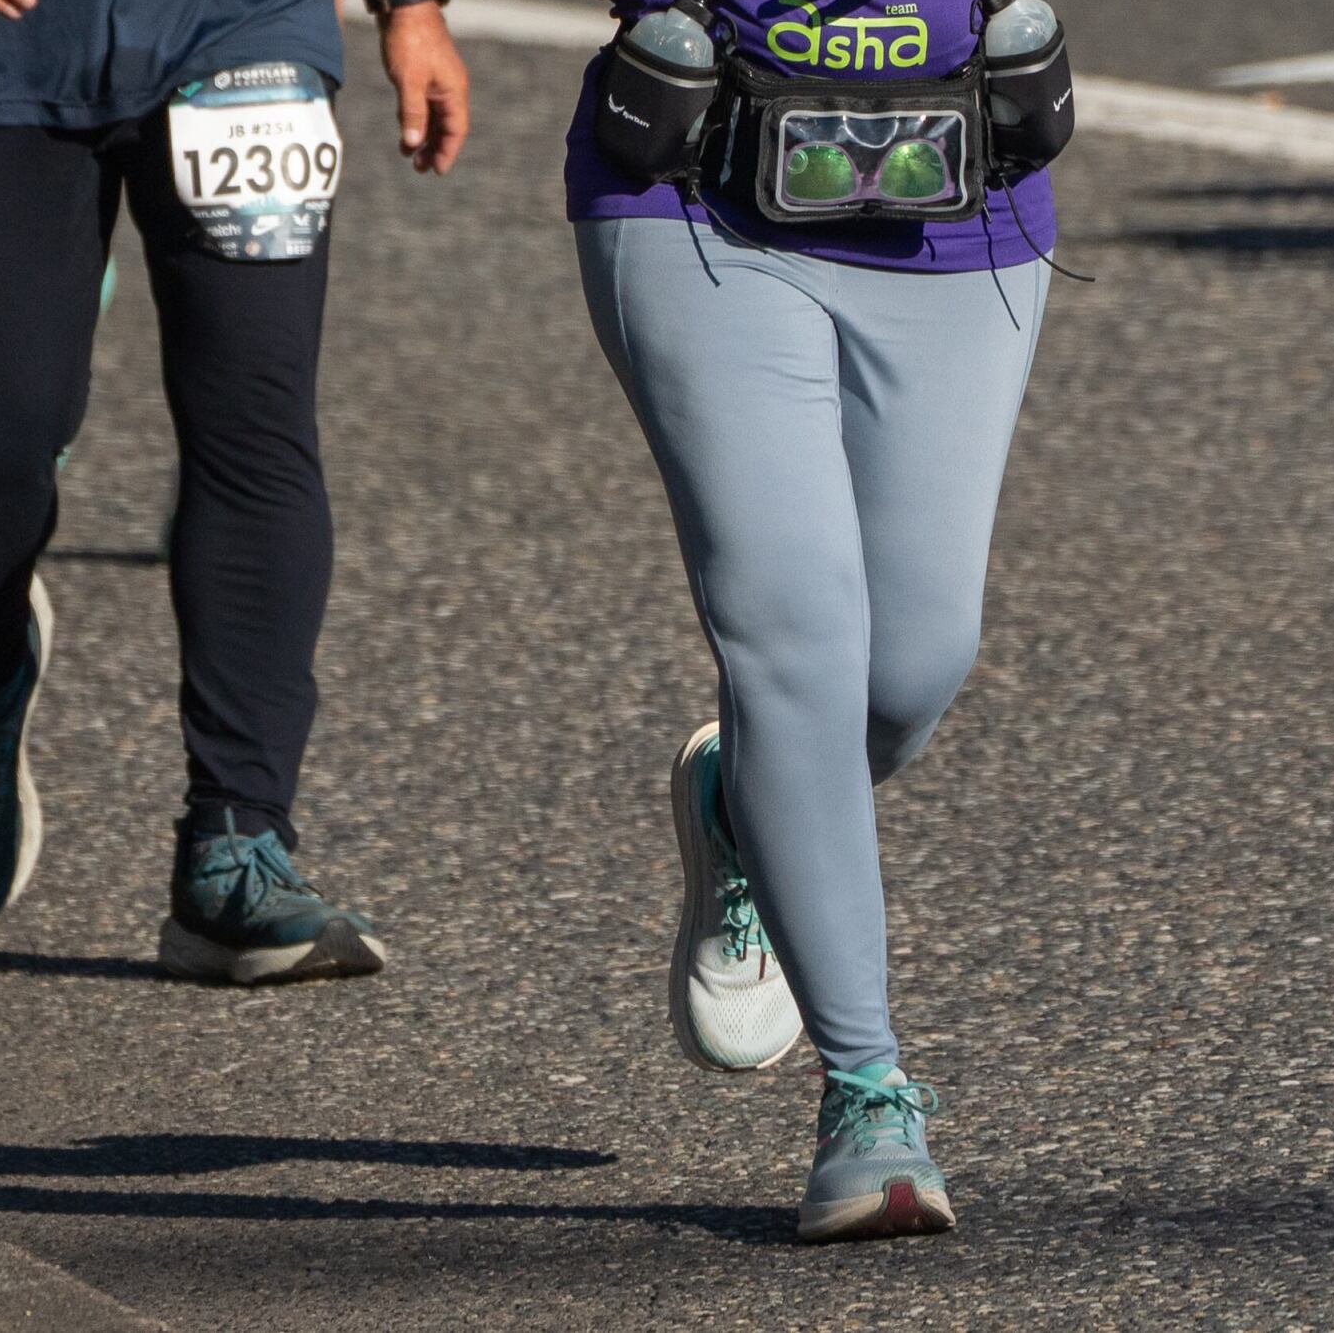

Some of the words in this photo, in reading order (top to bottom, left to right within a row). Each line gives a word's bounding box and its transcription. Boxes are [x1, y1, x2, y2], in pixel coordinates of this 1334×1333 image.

[885, 3, 918, 15] team
[233, 66, 297, 81] PORTLAND
[228, 124, 245, 139] JB
[183, 142, 338, 199] 12309
